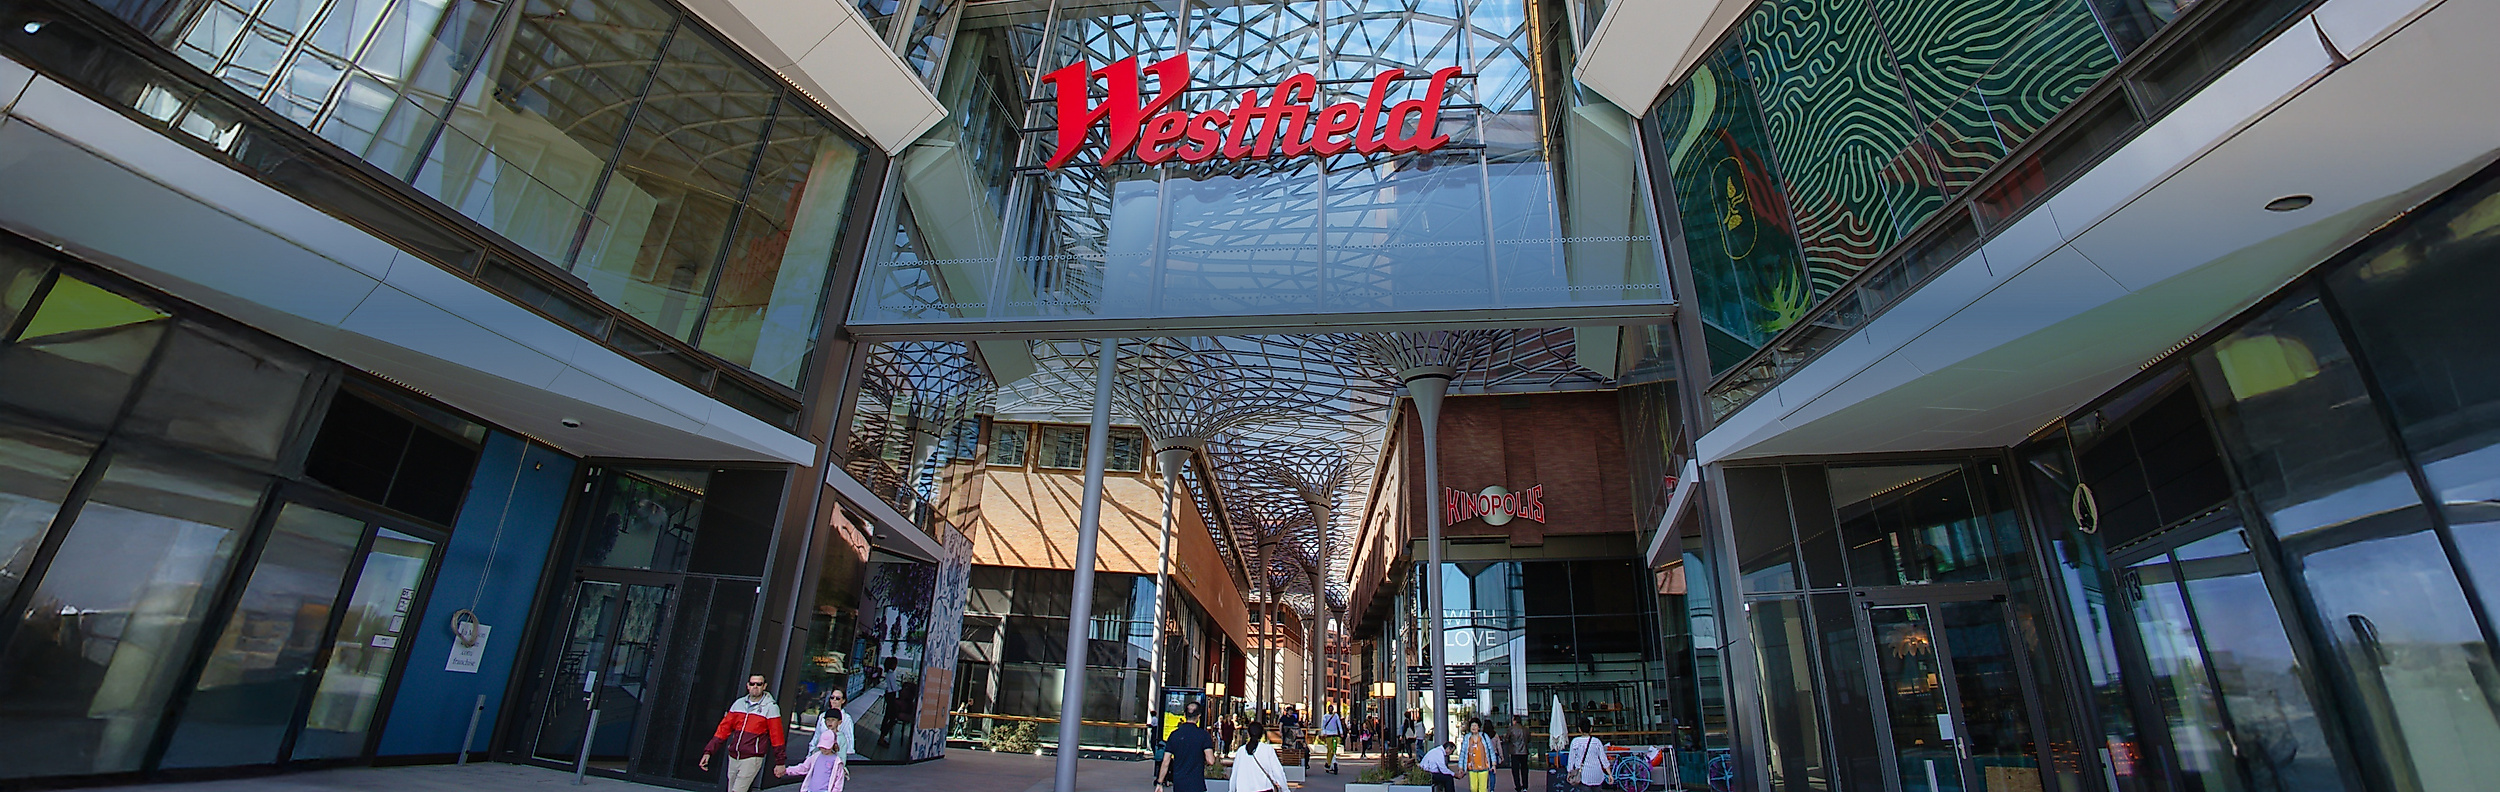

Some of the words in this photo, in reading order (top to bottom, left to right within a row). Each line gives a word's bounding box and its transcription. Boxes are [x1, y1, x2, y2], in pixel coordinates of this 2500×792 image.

[1042, 52, 1462, 171] Westfield
[1445, 484, 1546, 526] KINOPOLIS
[1443, 609, 1496, 625] WITH
[1445, 630, 1497, 646] LOVE
